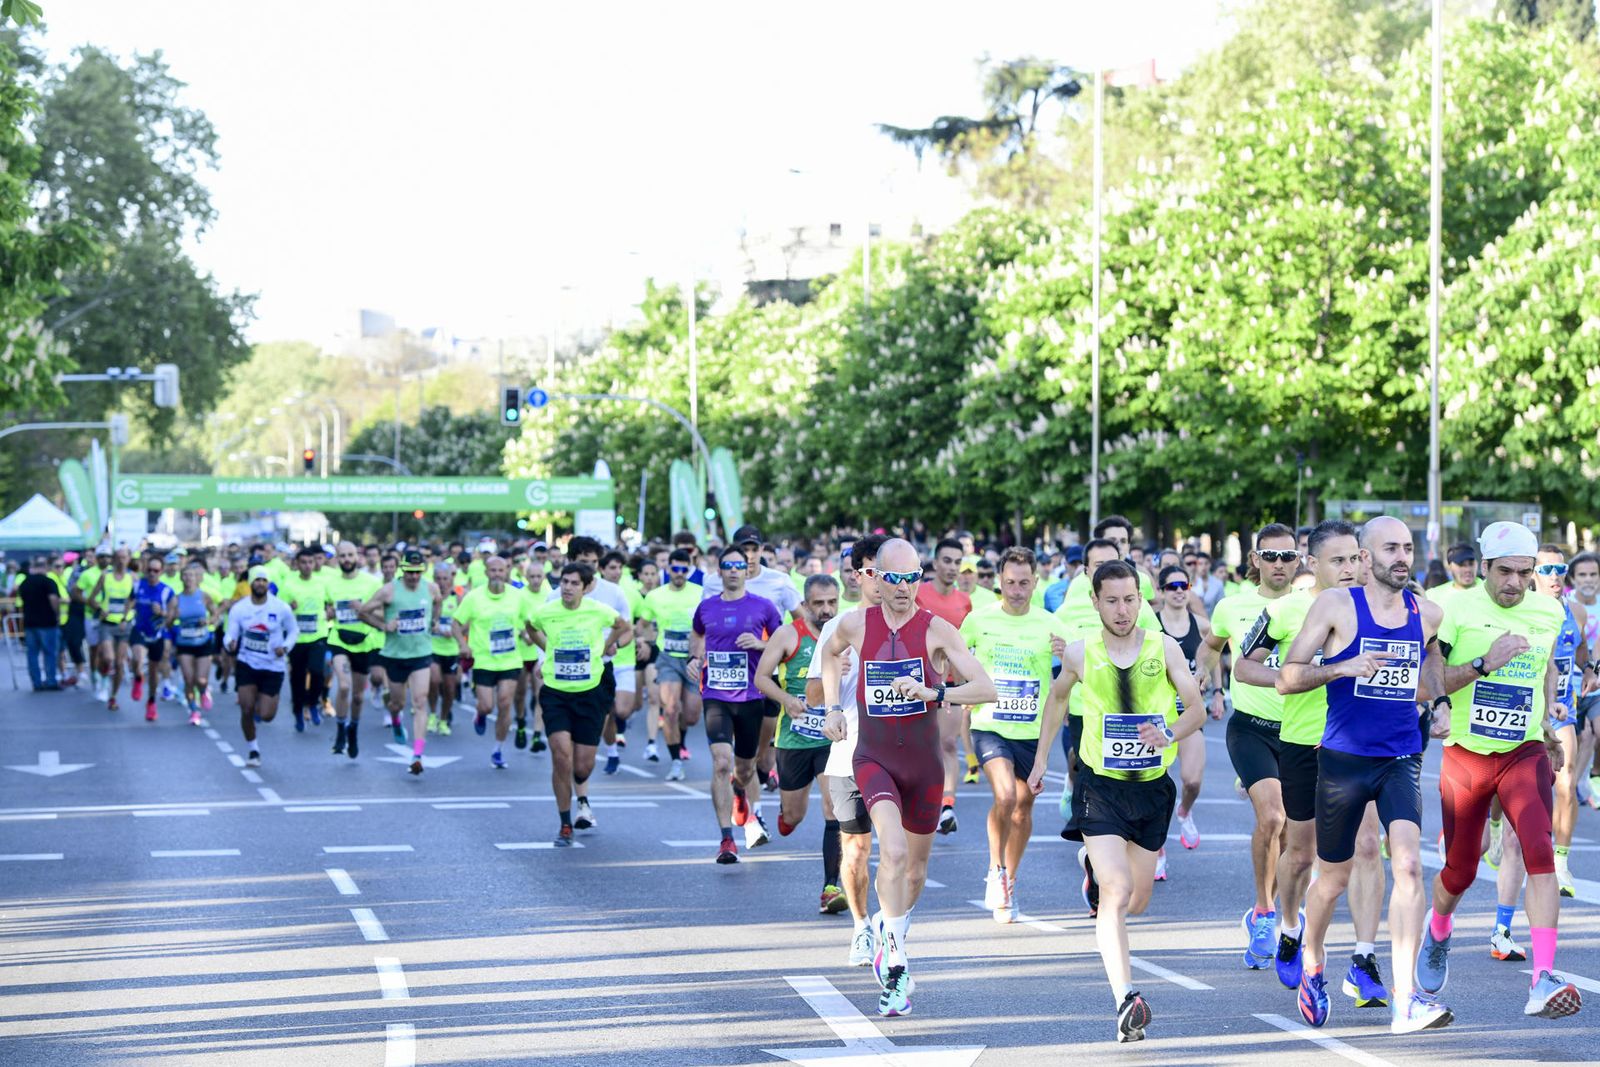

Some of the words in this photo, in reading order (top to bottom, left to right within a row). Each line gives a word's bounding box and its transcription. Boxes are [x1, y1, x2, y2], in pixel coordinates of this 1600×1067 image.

[285, 482, 330, 493] MADRID
[332, 482, 347, 493] EN
[349, 482, 397, 493] MARCHA
[399, 482, 446, 493] CONTRA
[559, 664, 586, 675] 2525
[994, 660, 1023, 668] CONTRA
[1504, 662, 1532, 670] ONTRA
[710, 668, 746, 681] 13689
[873, 688, 916, 704] 944
[995, 698, 1038, 711] 11886
[1250, 717, 1280, 729] NIKE
[1474, 708, 1527, 728] 10721
[1111, 742, 1156, 757] 9274
